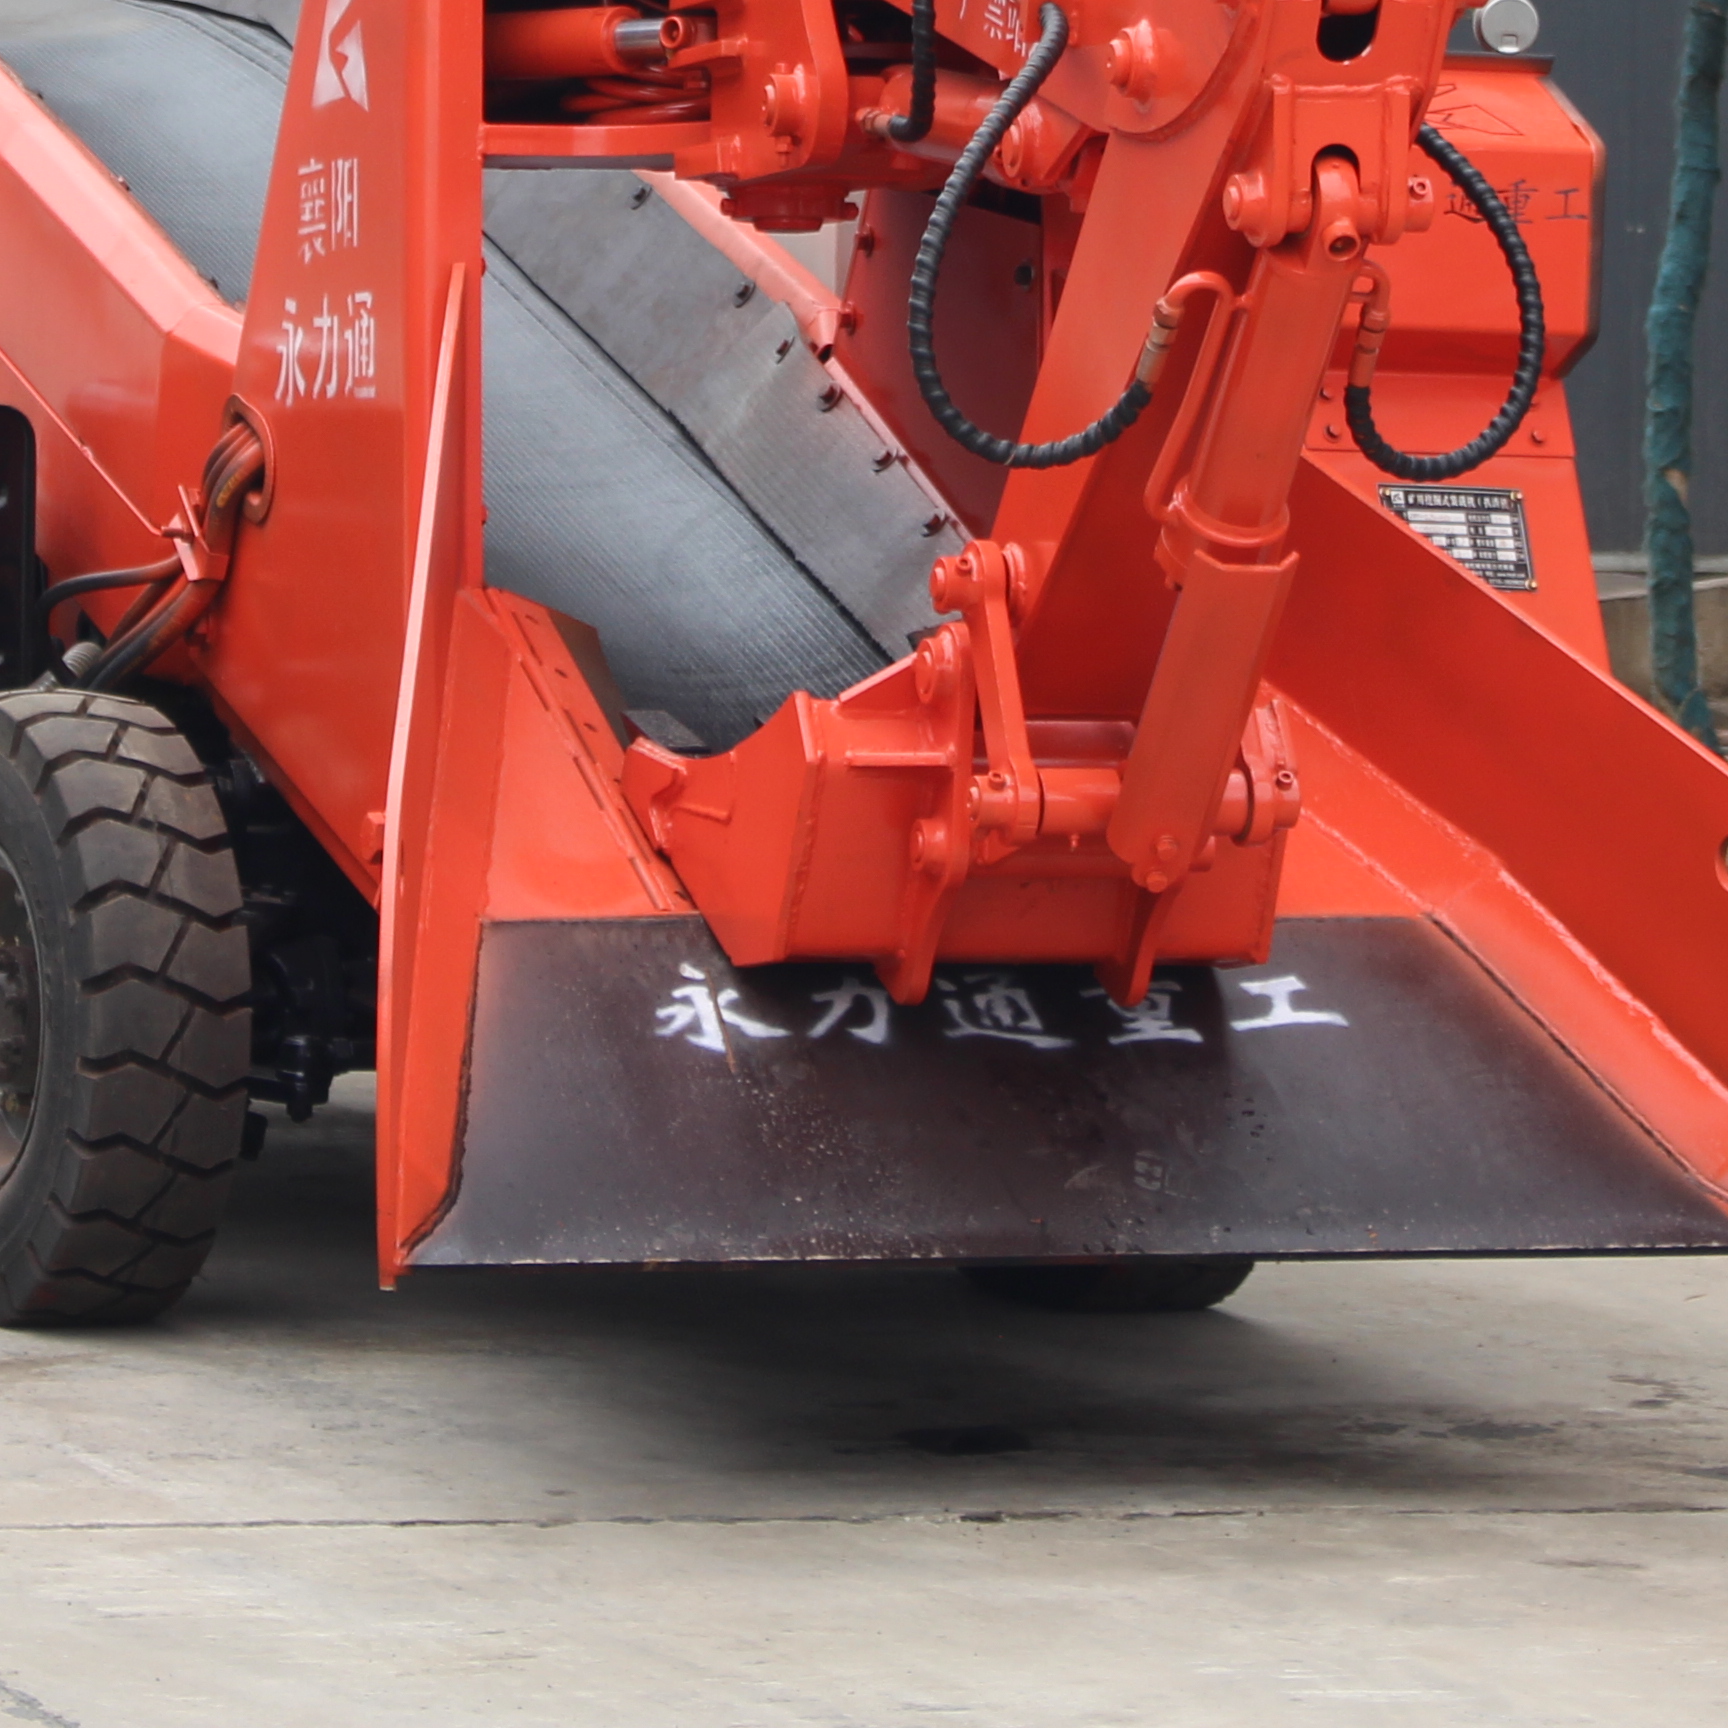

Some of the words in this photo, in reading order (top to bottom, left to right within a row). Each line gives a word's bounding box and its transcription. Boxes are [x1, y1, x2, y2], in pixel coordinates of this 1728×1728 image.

[297, 158, 359, 264] 襄阳
[274, 292, 376, 408] 永力通
[654, 963, 1350, 1050] 永力通重工
